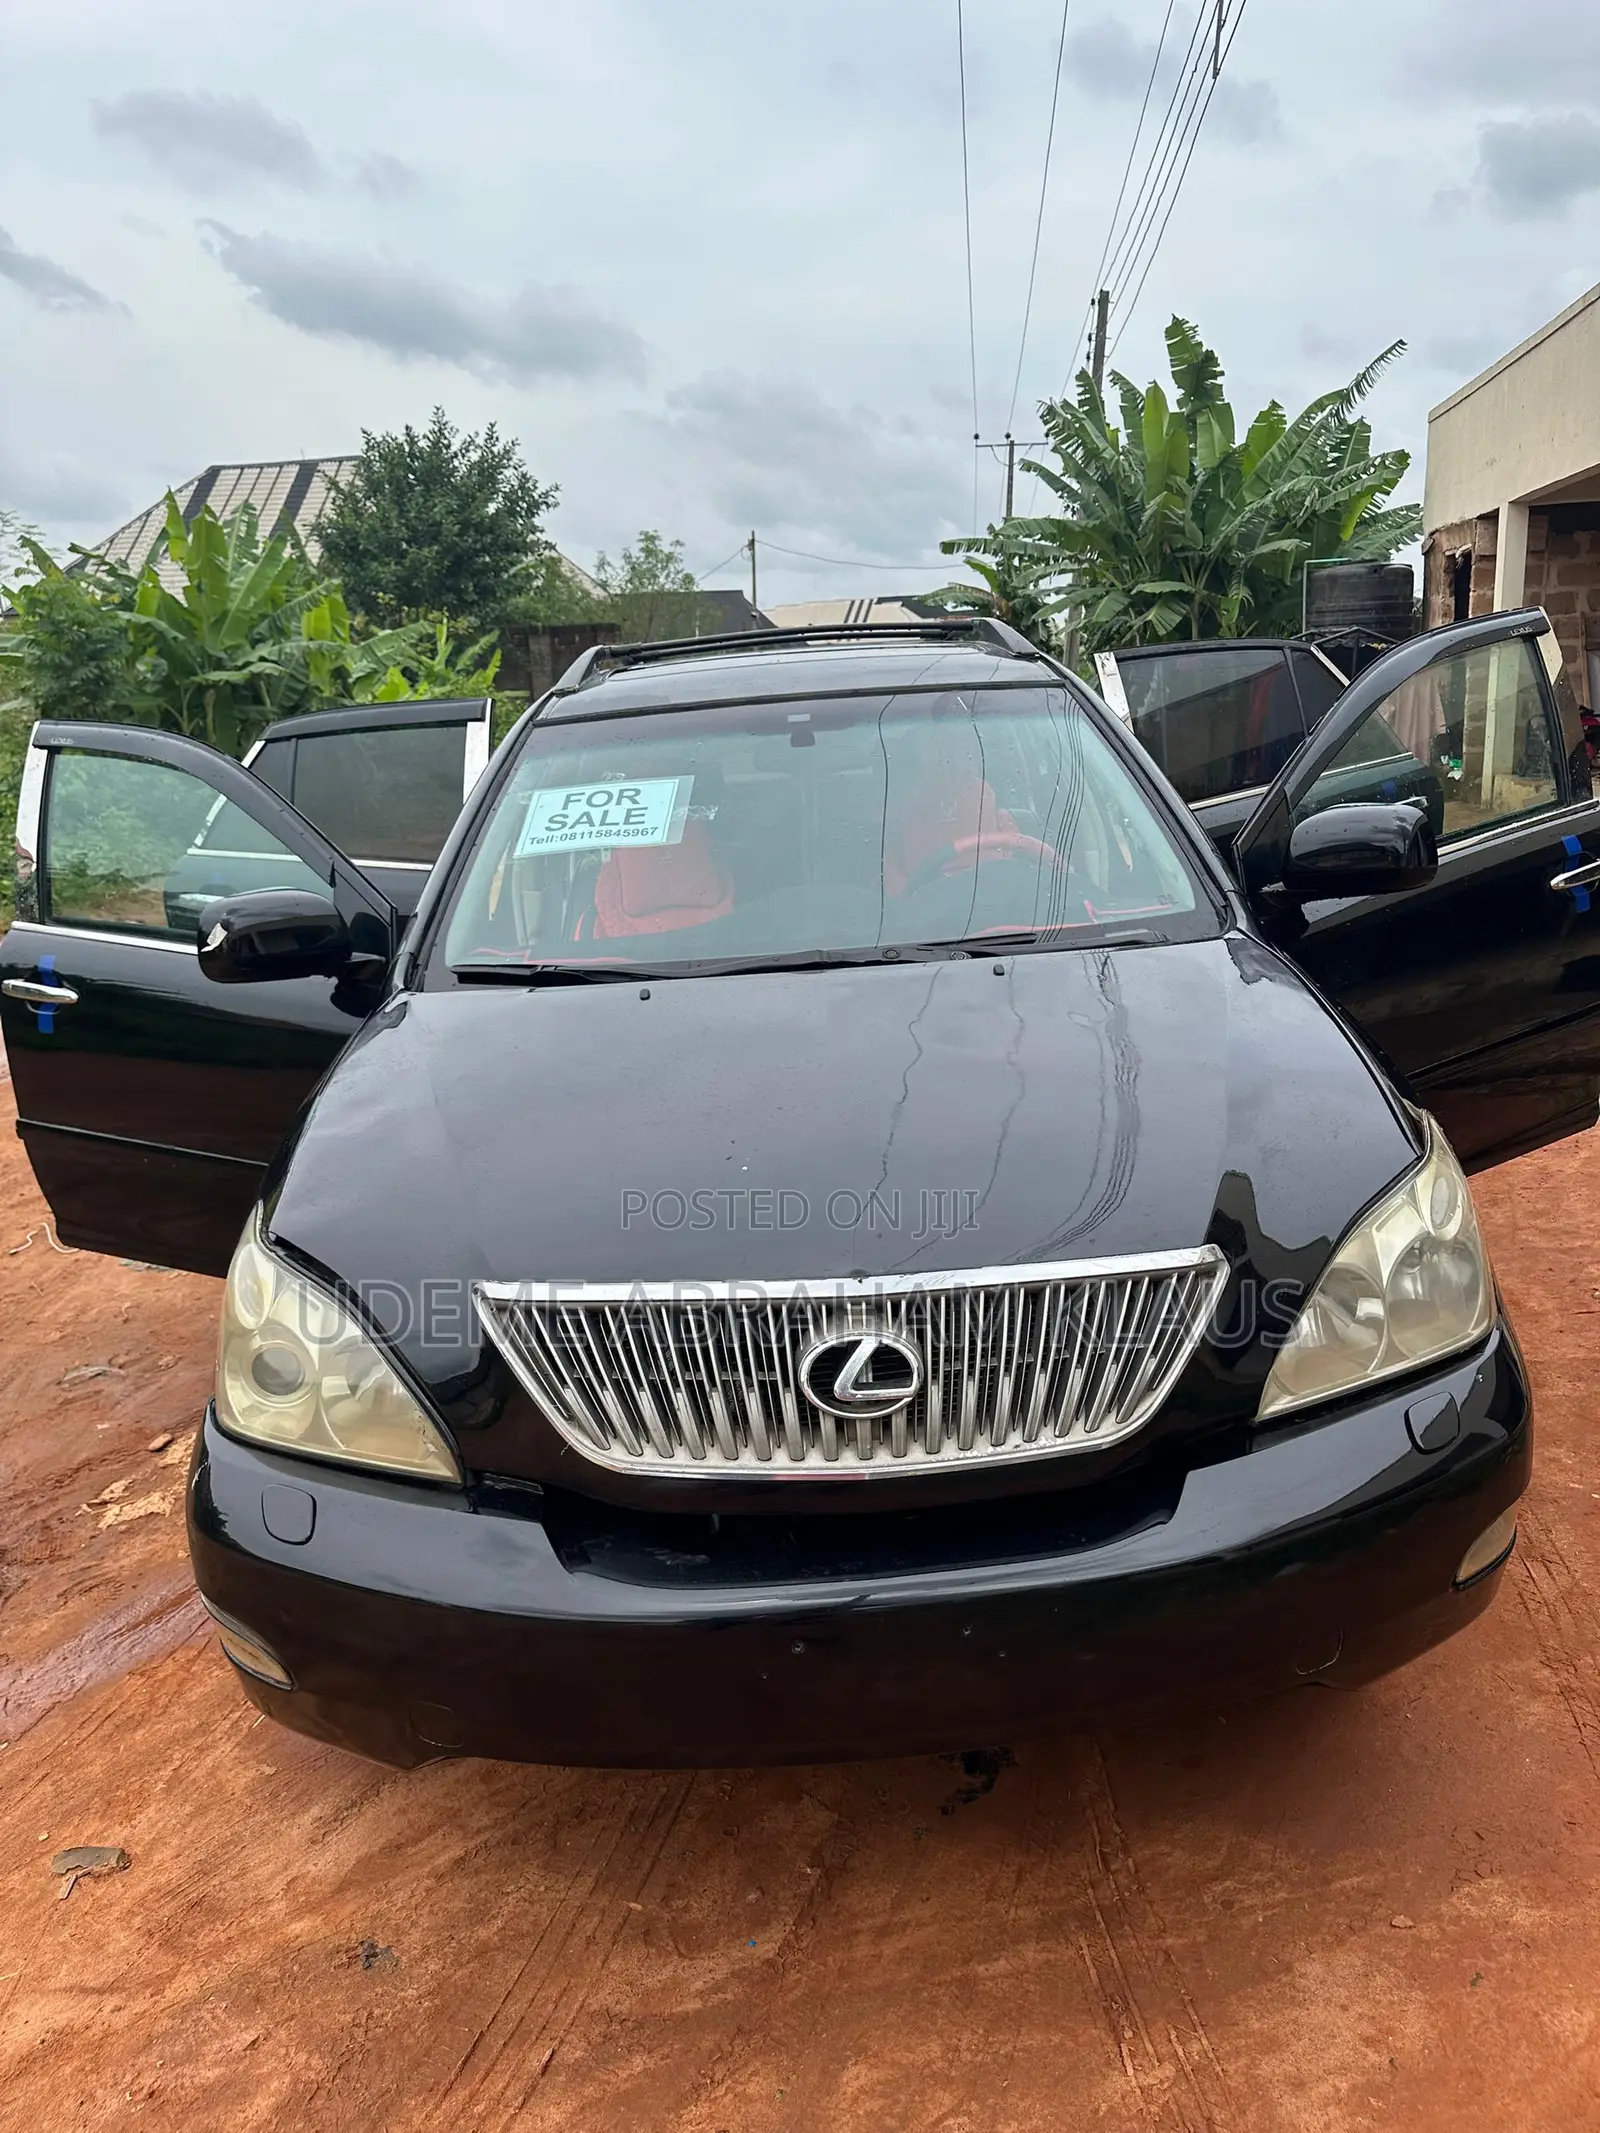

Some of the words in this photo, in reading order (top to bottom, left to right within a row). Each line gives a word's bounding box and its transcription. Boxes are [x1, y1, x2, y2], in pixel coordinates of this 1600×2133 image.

[1510, 625, 1533, 636] LEXUS
[562, 788, 642, 811] FOR
[545, 807, 648, 832] SALE
[529, 827, 658, 845] Tell:08115845967
